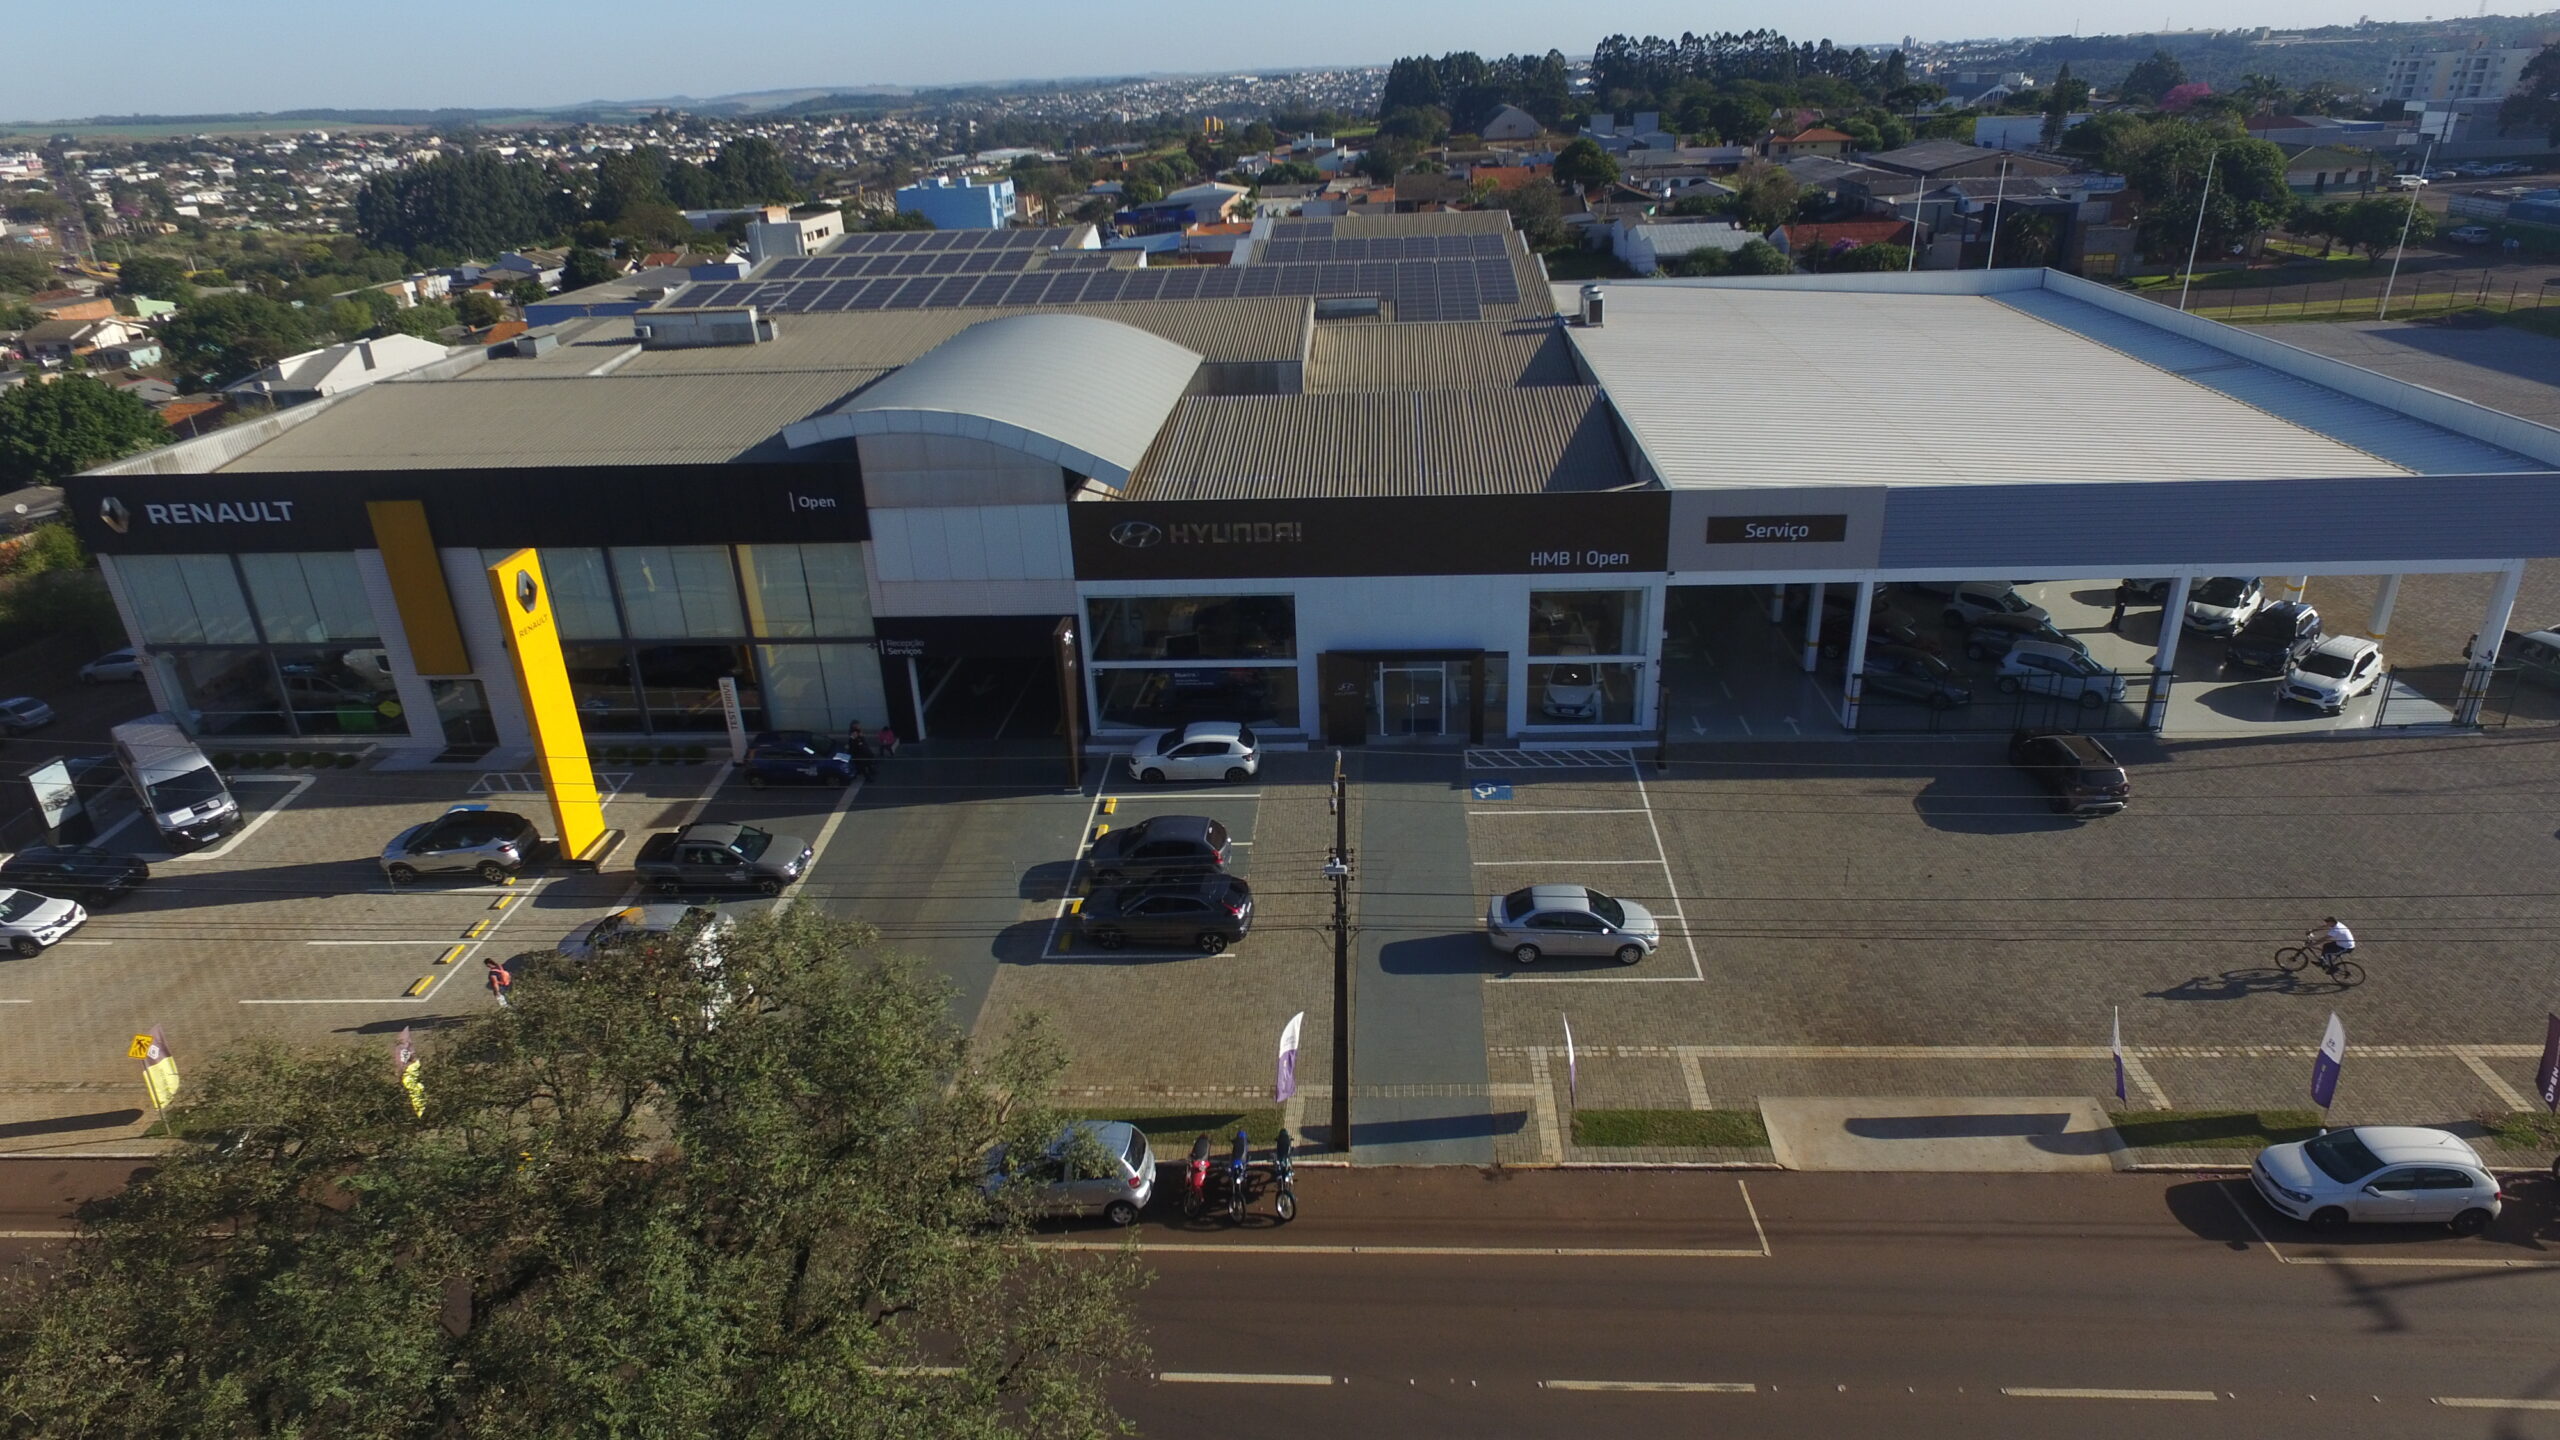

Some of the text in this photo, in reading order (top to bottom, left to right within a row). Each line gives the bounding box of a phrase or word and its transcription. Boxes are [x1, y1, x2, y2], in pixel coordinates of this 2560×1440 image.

[145, 501, 294, 525] RENAULT
[798, 496, 837, 509] Open
[1168, 521, 1302, 544] HYUNDAI
[1744, 523, 1809, 541] Serviço
[1530, 550, 1629, 568] HMB Open
[519, 613, 548, 637] RENAULT
[727, 711, 739, 730] TEST
[2544, 1066, 2560, 1103] OPEN
